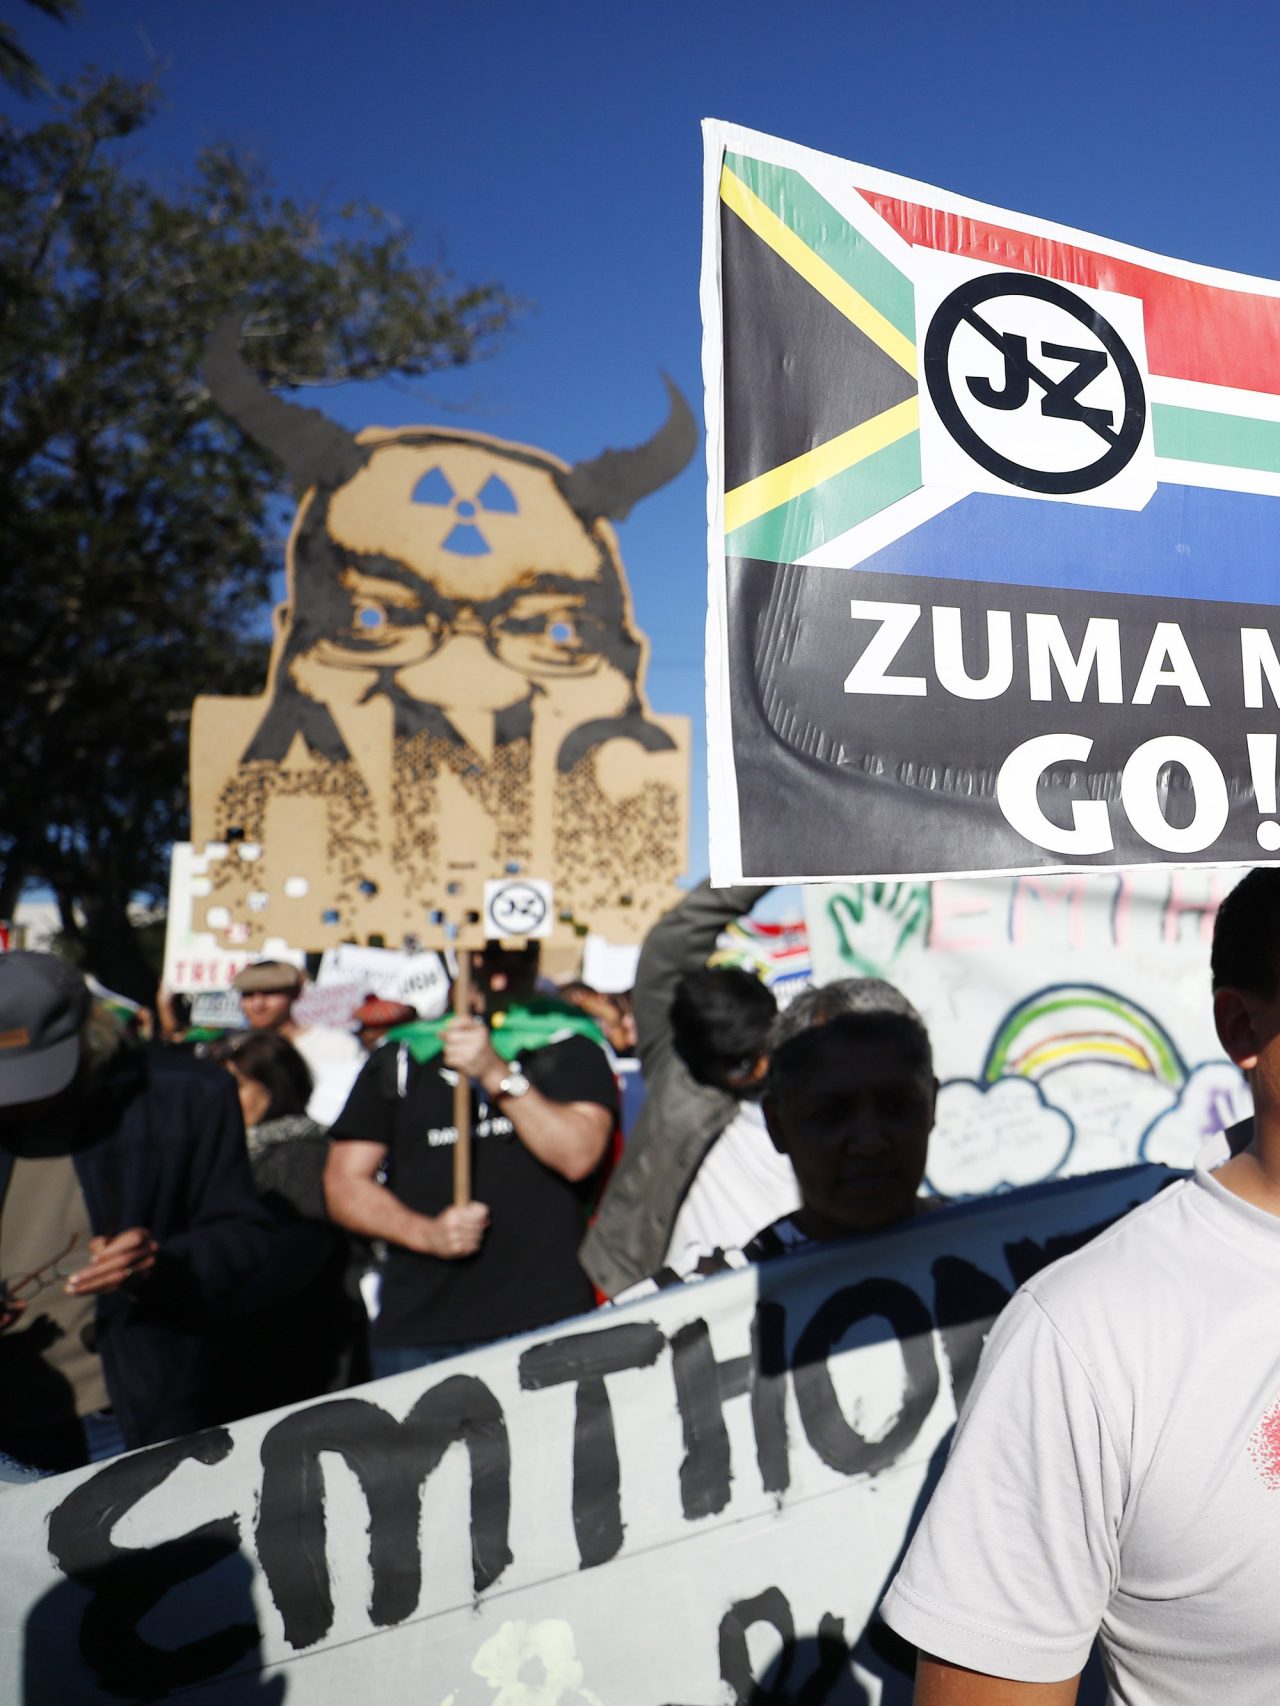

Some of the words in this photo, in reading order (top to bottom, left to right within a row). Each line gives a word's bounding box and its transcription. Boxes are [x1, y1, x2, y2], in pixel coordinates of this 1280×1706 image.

[966, 332, 1114, 434] JZ
[843, 599, 1211, 707] ZUMA
[212, 696, 682, 905] ANC
